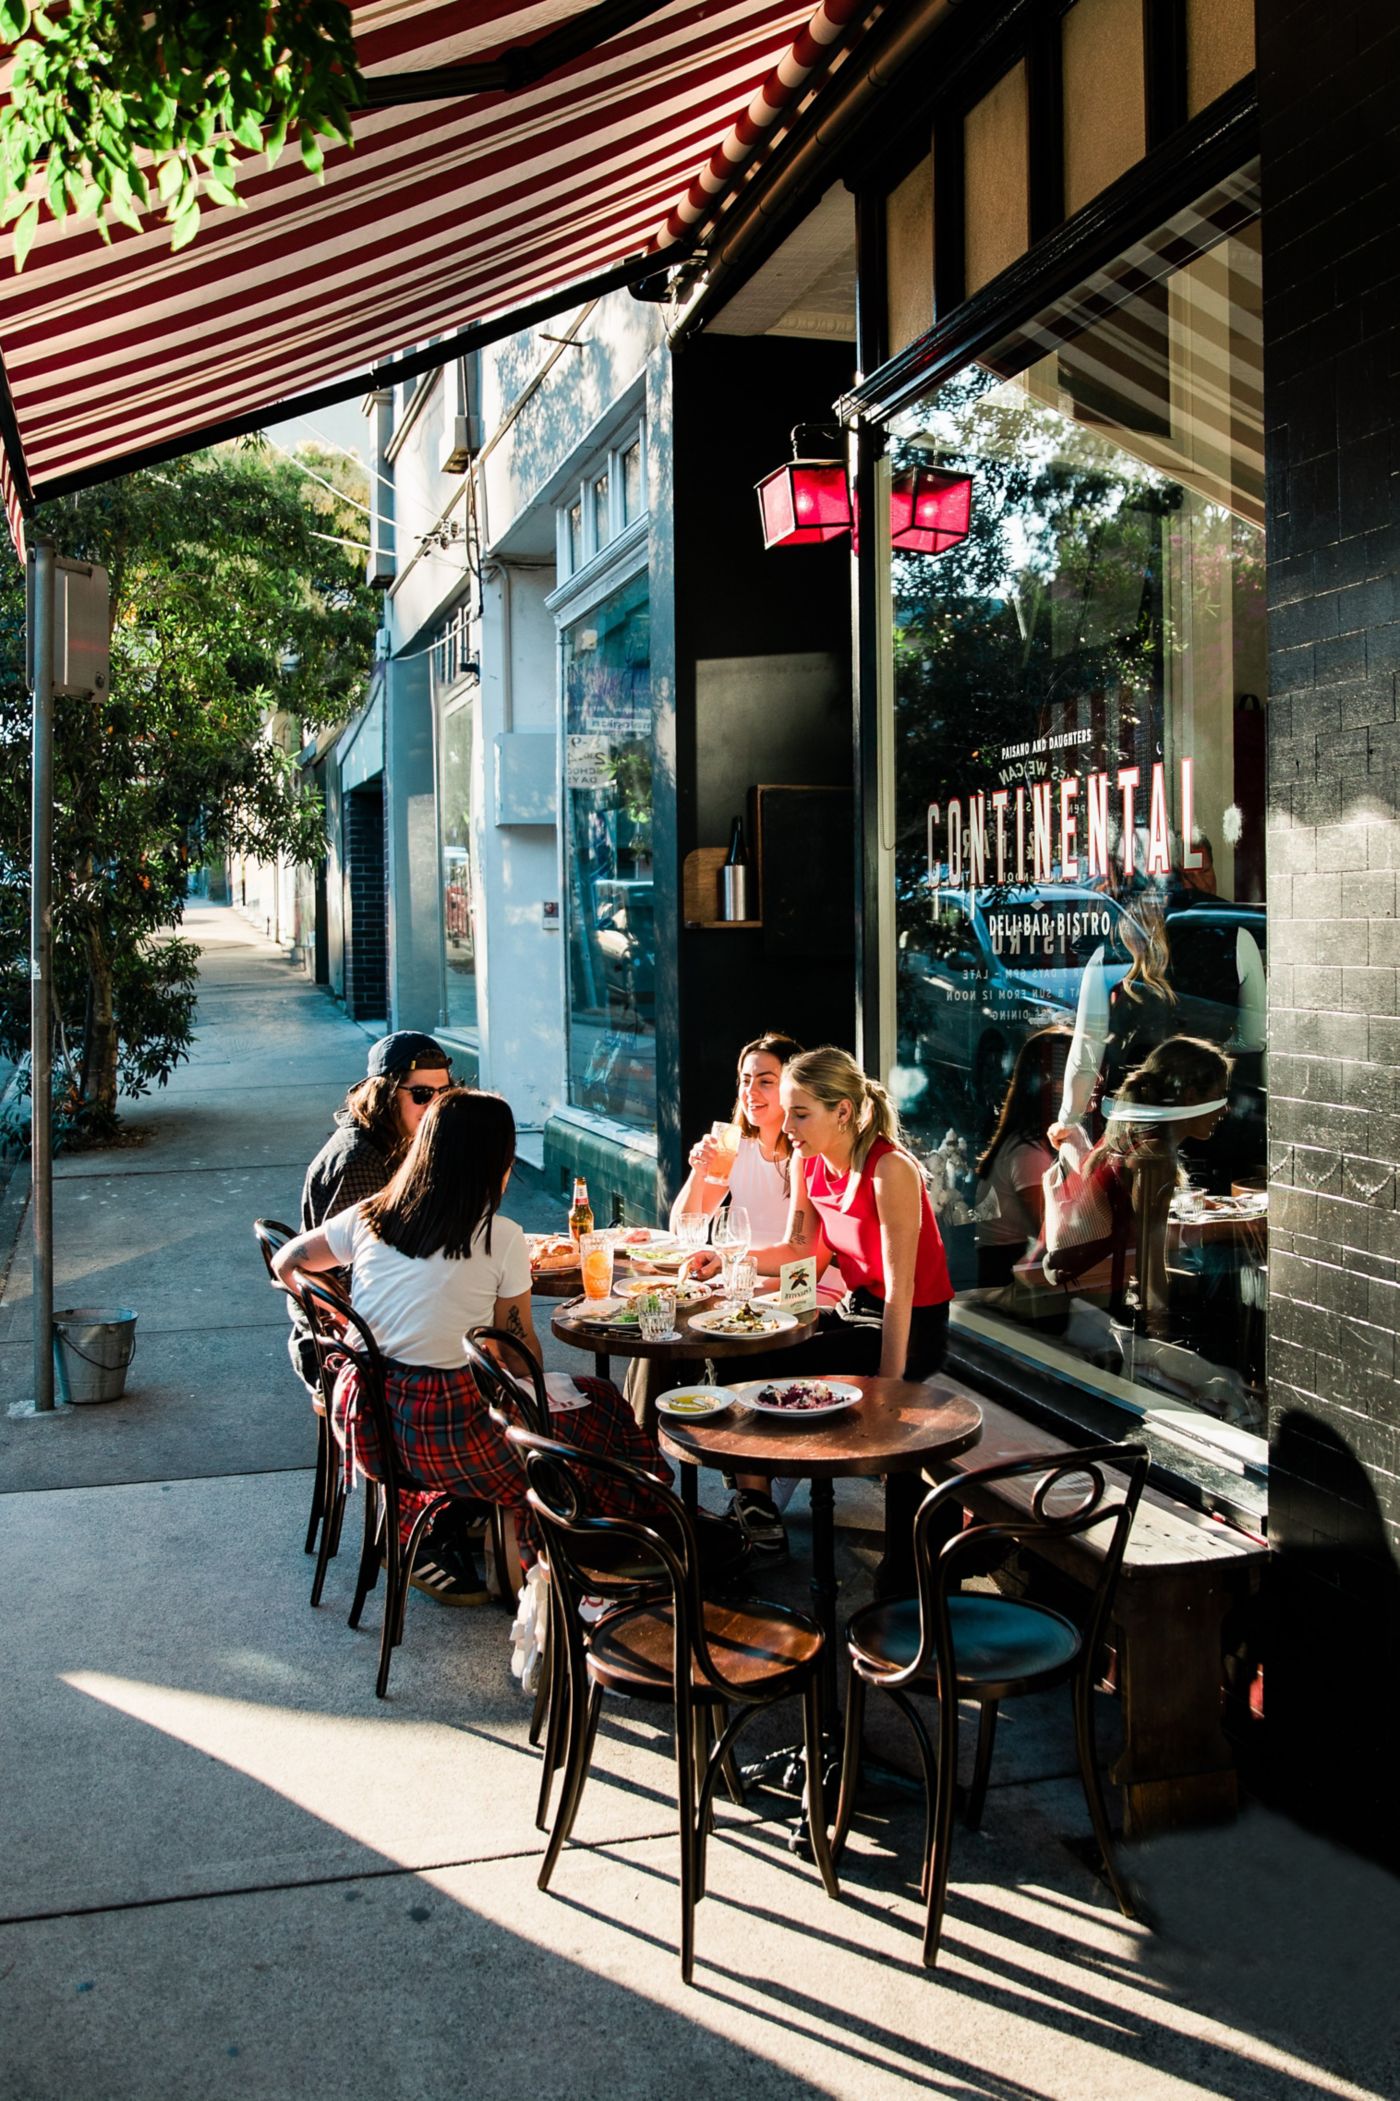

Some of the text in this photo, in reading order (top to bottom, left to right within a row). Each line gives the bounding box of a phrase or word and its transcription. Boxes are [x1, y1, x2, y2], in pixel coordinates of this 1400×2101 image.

[1001, 729, 1092, 760] PAISANO AND DAUGHTERS
[926, 756, 1204, 888] CONTINENTAL
[989, 911, 1111, 937] DELI BAR BISTRO
